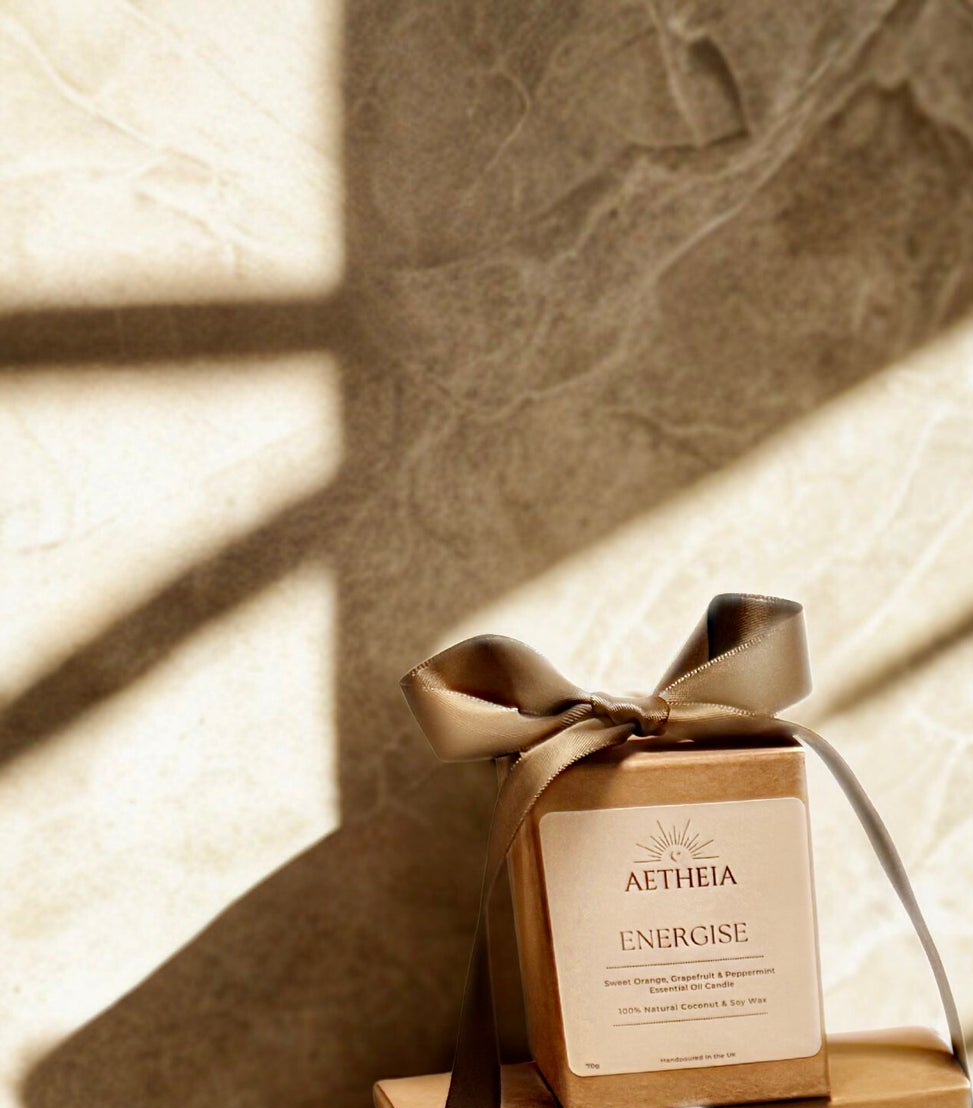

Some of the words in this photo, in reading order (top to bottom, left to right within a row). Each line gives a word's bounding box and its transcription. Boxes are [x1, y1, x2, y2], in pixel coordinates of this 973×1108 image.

[624, 865, 738, 892] AETHEIA
[619, 922, 749, 951] ENERGISE
[604, 979, 631, 989] Sweet
[633, 976, 669, 986] Orange,
[671, 972, 715, 984] Grapefruit
[717, 971, 723, 979] &
[725, 967, 775, 980] Peppermint
[650, 984, 688, 994] Essential
[690, 983, 703, 991] Oil
[704, 981, 735, 990] Candle
[618, 1006, 642, 1015] 100%
[644, 1003, 678, 1014] Natural
[681, 1001, 718, 1011] Coconut
[730, 998, 745, 1008] Soy
[748, 997, 767, 1005] Wax
